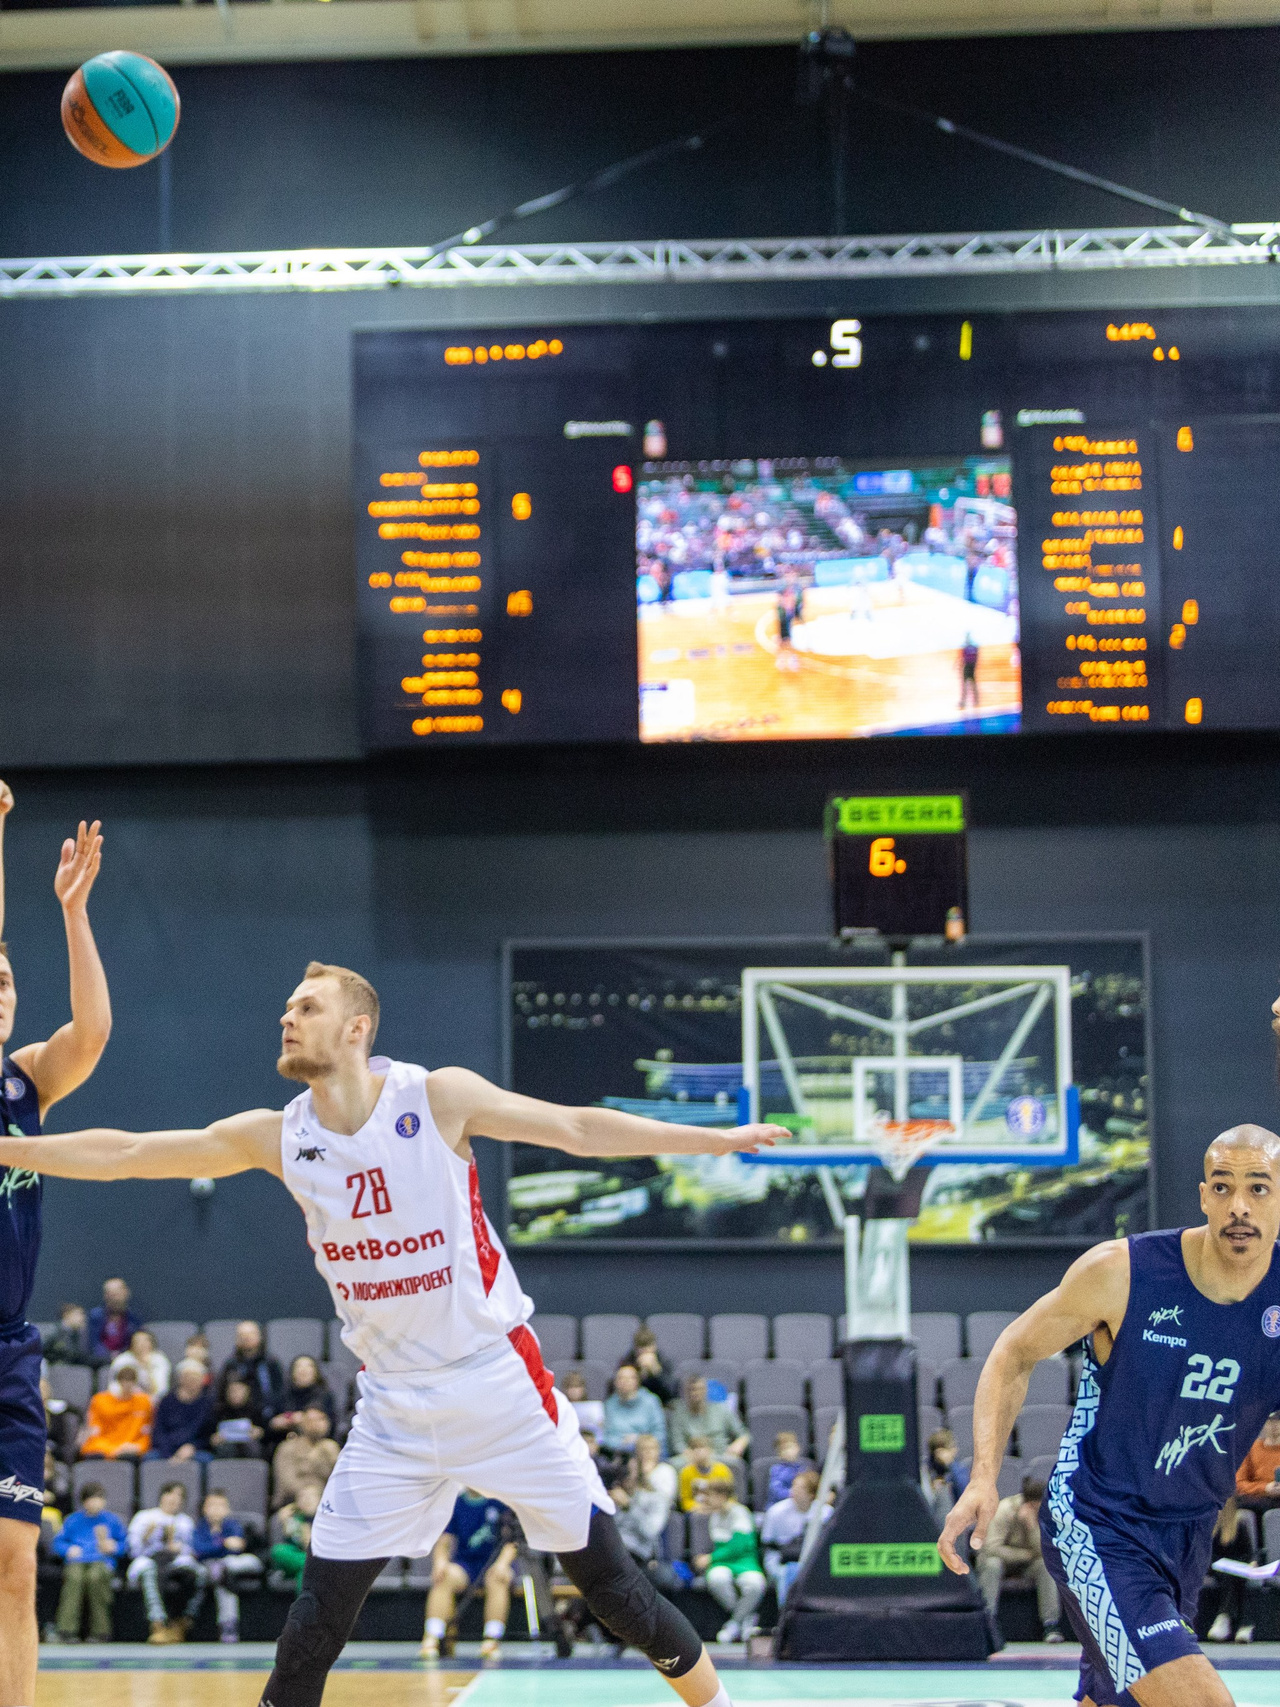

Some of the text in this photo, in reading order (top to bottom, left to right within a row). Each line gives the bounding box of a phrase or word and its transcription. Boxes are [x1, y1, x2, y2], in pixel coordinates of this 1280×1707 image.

[346, 1167, 392, 1219] 28
[322, 1229, 445, 1261] BetBoom
[352, 1265, 452, 1300] МОСИНЖПРОЕКТ
[1142, 1329, 1187, 1348] Kempa
[1180, 1353, 1241, 1403] 22
[1137, 1618, 1180, 1640] Kempa
